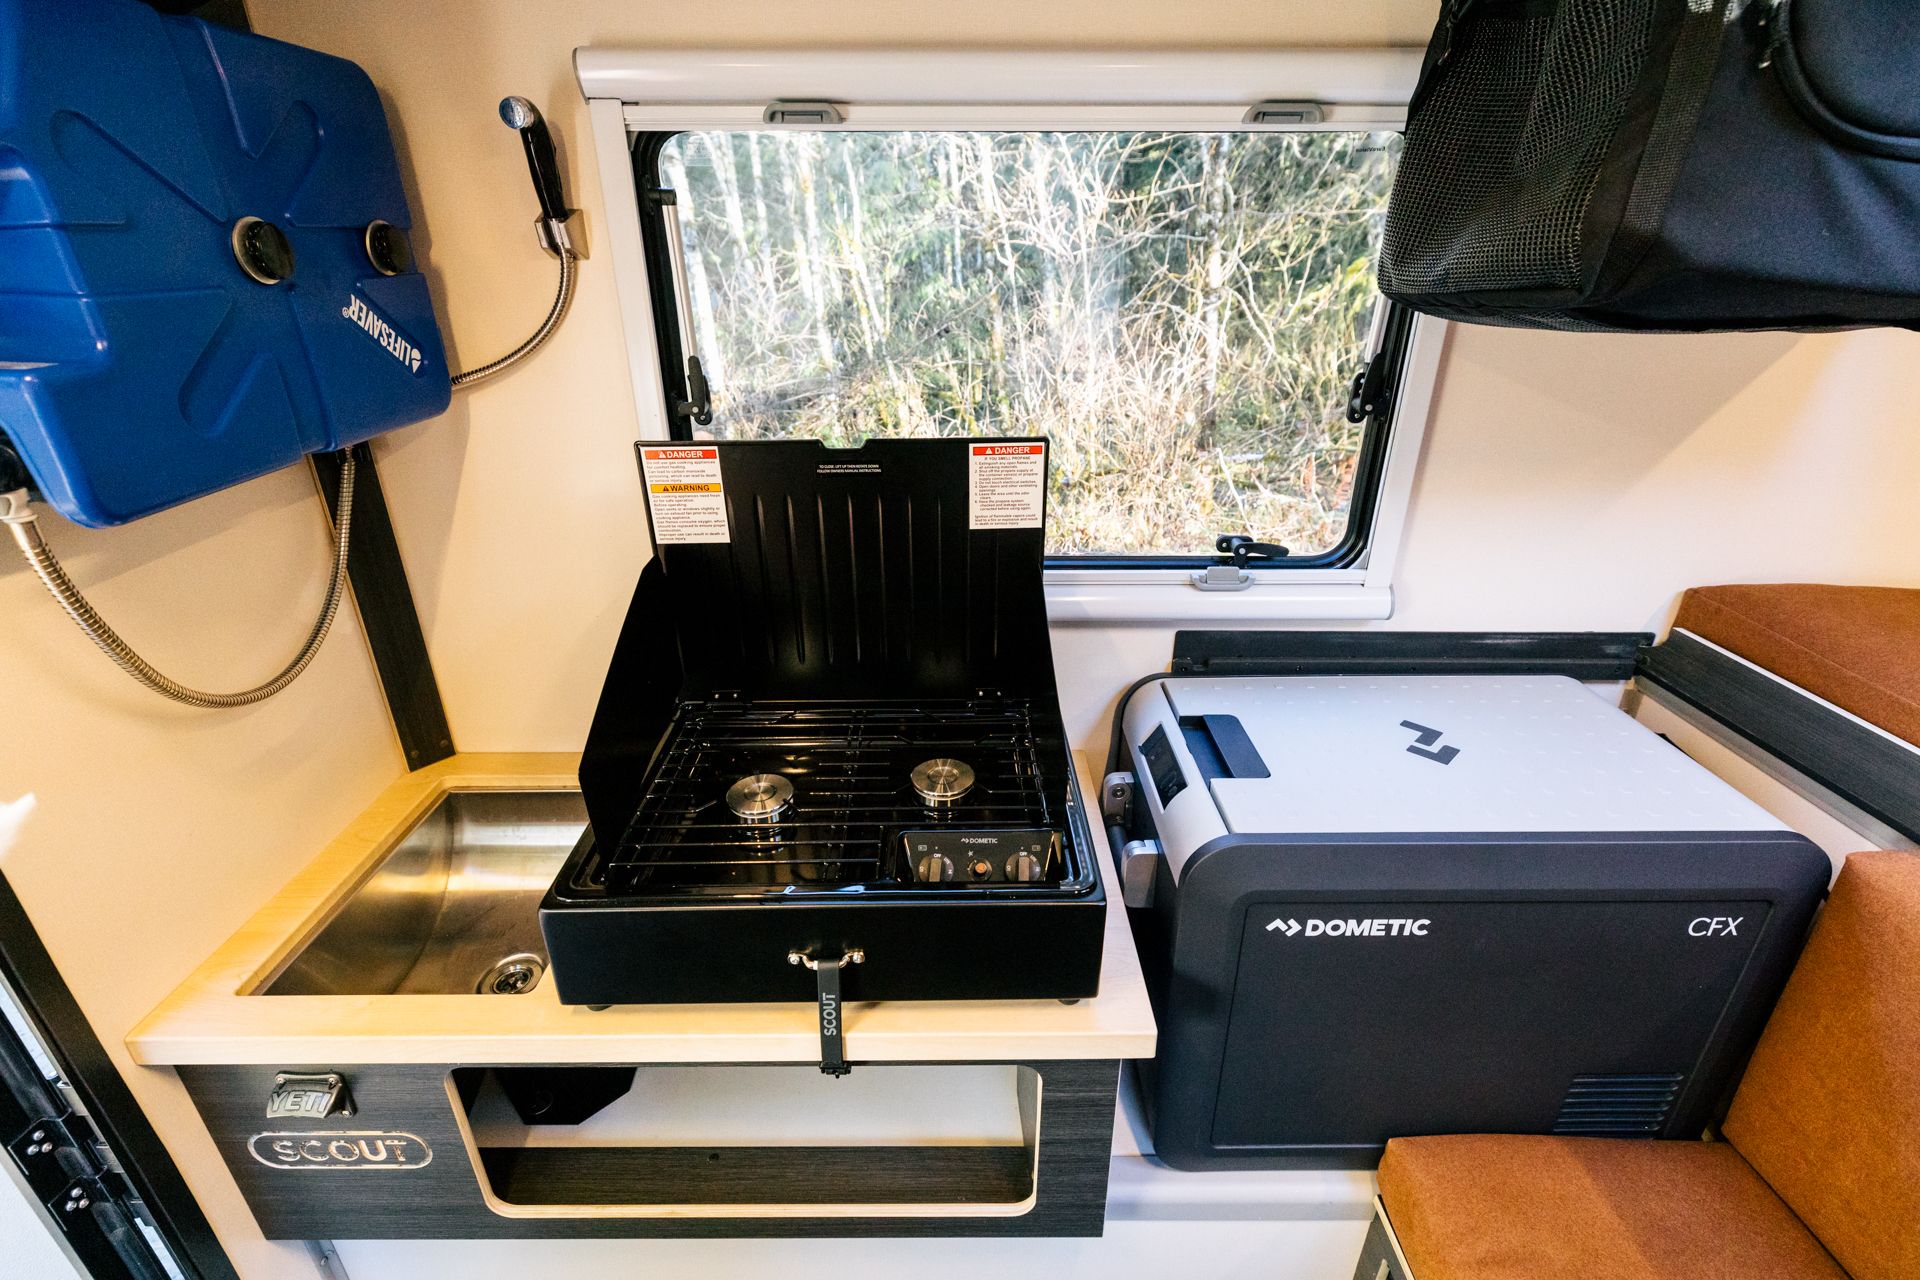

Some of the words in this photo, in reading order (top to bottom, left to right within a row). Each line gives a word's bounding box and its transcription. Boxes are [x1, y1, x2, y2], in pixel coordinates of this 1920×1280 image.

[1304, 919, 1431, 936] DOMETIC
[1688, 917, 1744, 936] CFX
[823, 993, 836, 1036] SCOUT
[271, 1091, 332, 1112] YETI
[272, 1140, 407, 1161] SCOUT
